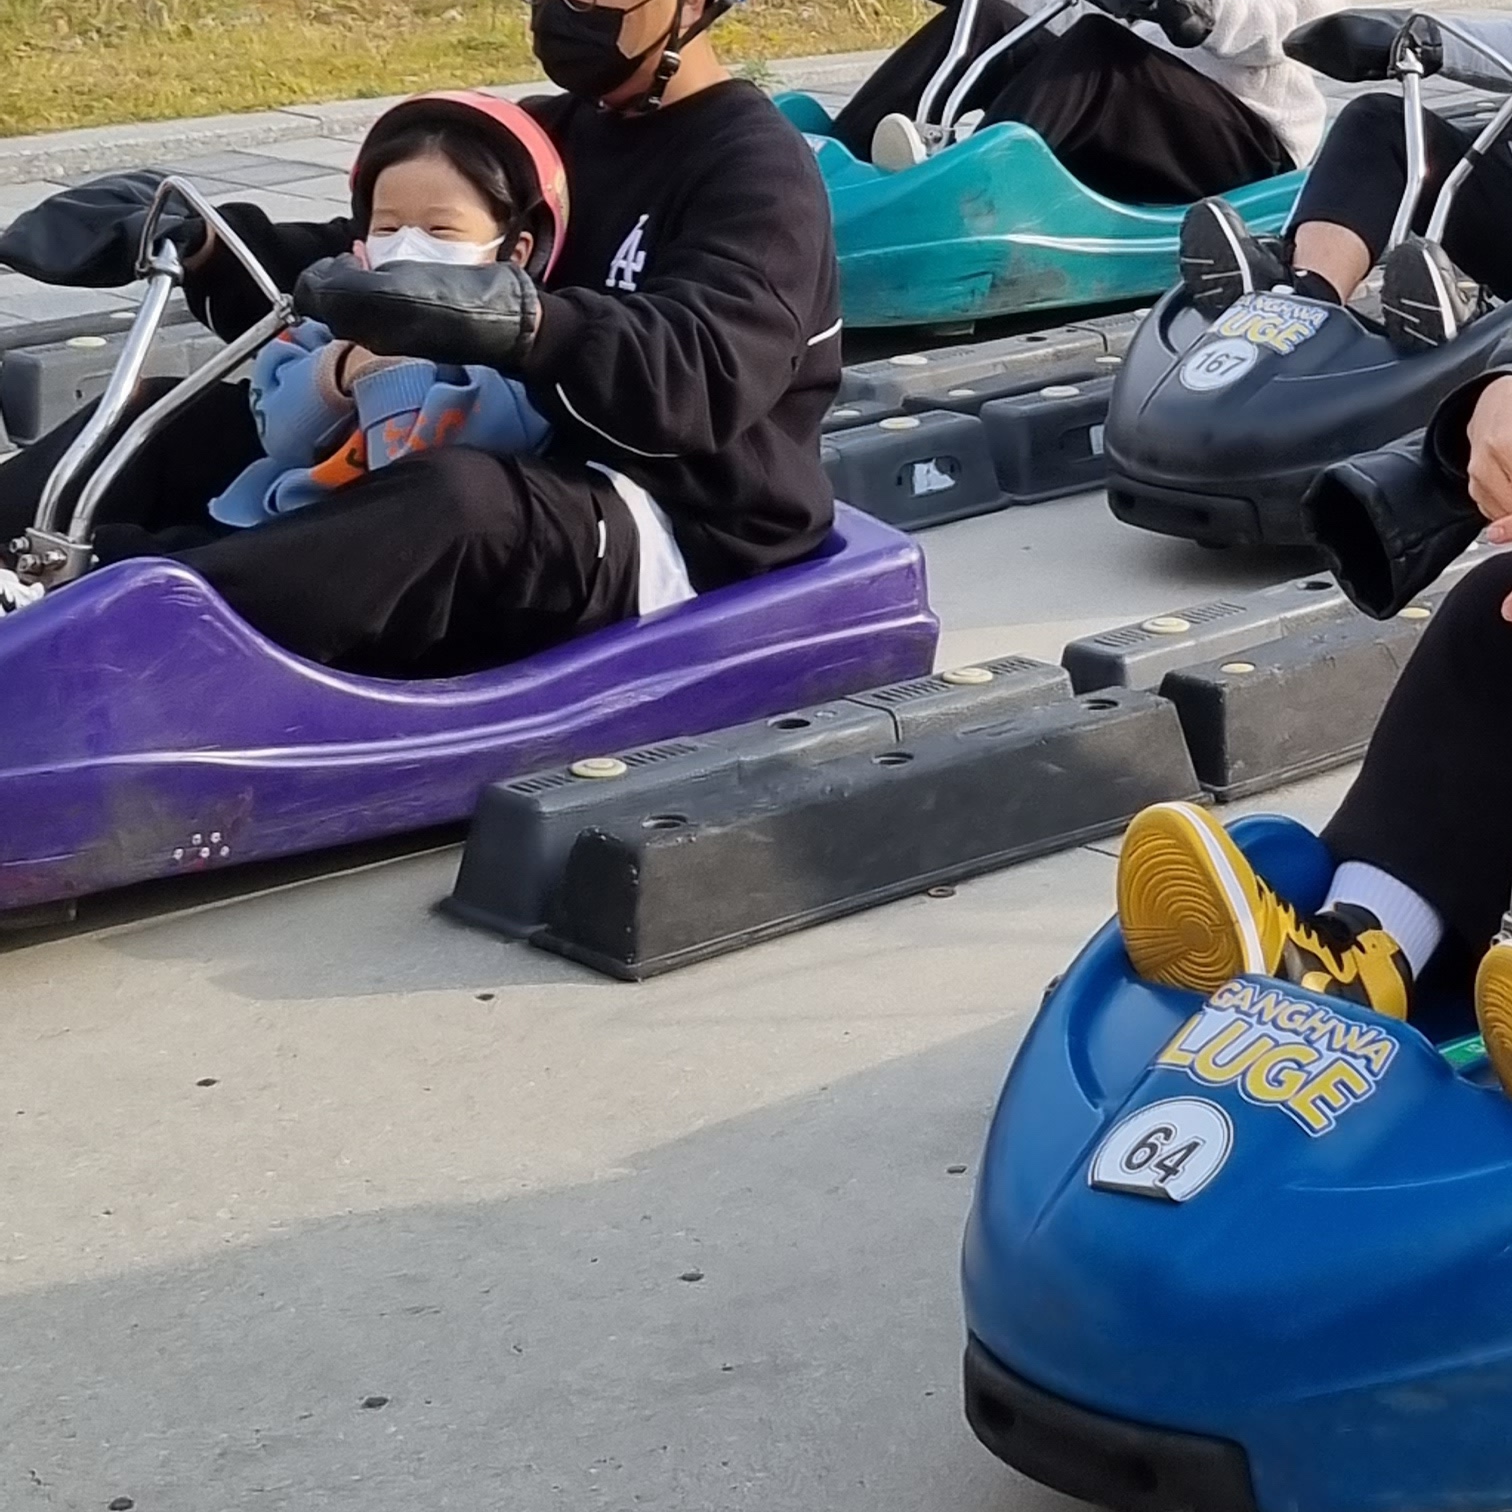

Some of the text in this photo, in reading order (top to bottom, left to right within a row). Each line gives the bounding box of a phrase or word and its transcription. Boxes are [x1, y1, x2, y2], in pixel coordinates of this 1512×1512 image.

[1216, 304, 1314, 355] UGE
[1194, 351, 1248, 376] 167
[1209, 980, 1398, 1076] GANGHWA
[1157, 1012, 1374, 1133] LUGE
[1123, 1125, 1201, 1184] 64
